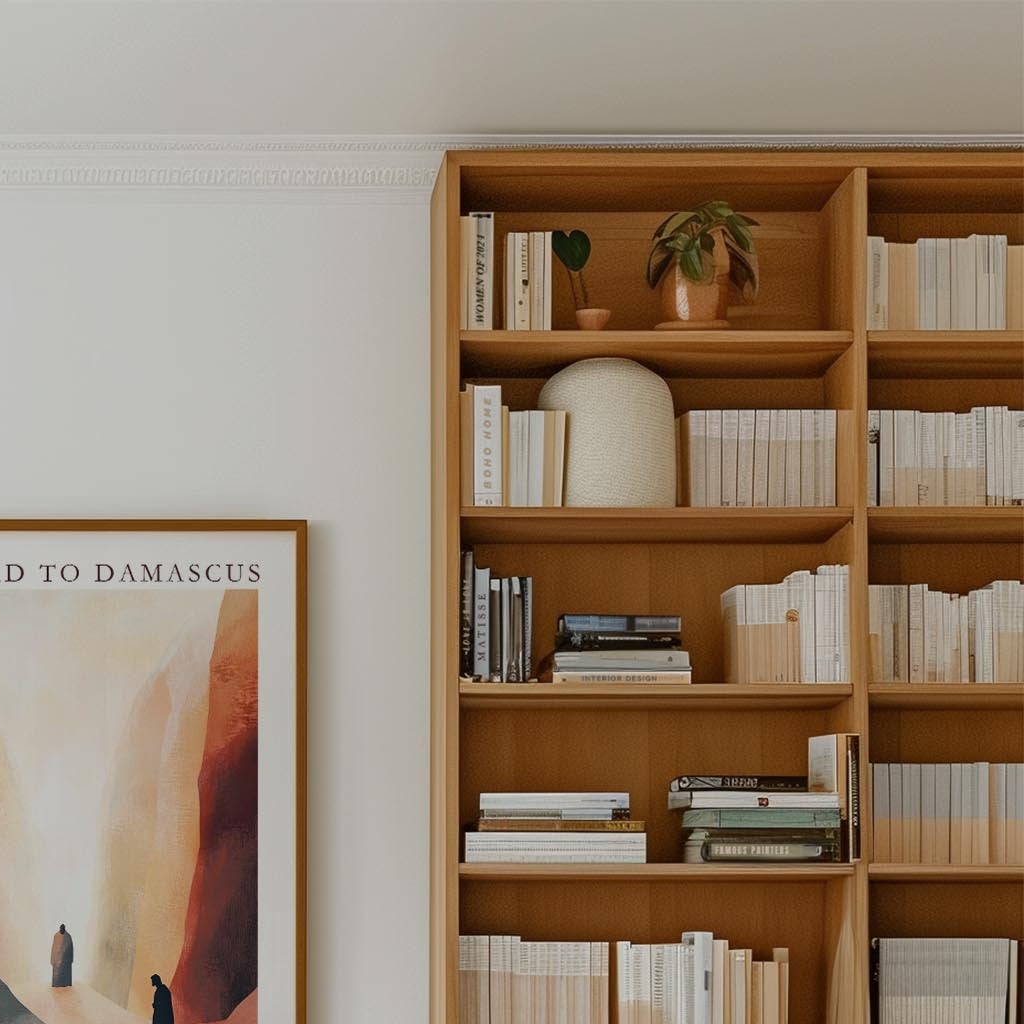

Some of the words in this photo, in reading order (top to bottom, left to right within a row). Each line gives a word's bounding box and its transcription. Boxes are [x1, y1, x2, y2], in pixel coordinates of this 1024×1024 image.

[476, 259, 485, 276] OF
[475, 279, 486, 324] WOMEN
[483, 398, 492, 440] HOME
[483, 447, 492, 489] BOHO
[39, 563, 80, 583] TO
[94, 563, 262, 583] DAMASCUS
[477, 593, 487, 661] MATISSE
[581, 674, 622, 683] INTERIOR
[625, 674, 658, 683] DESIGN
[714, 845, 748, 855] FAMOUS
[751, 845, 789, 855] PAINTERS
